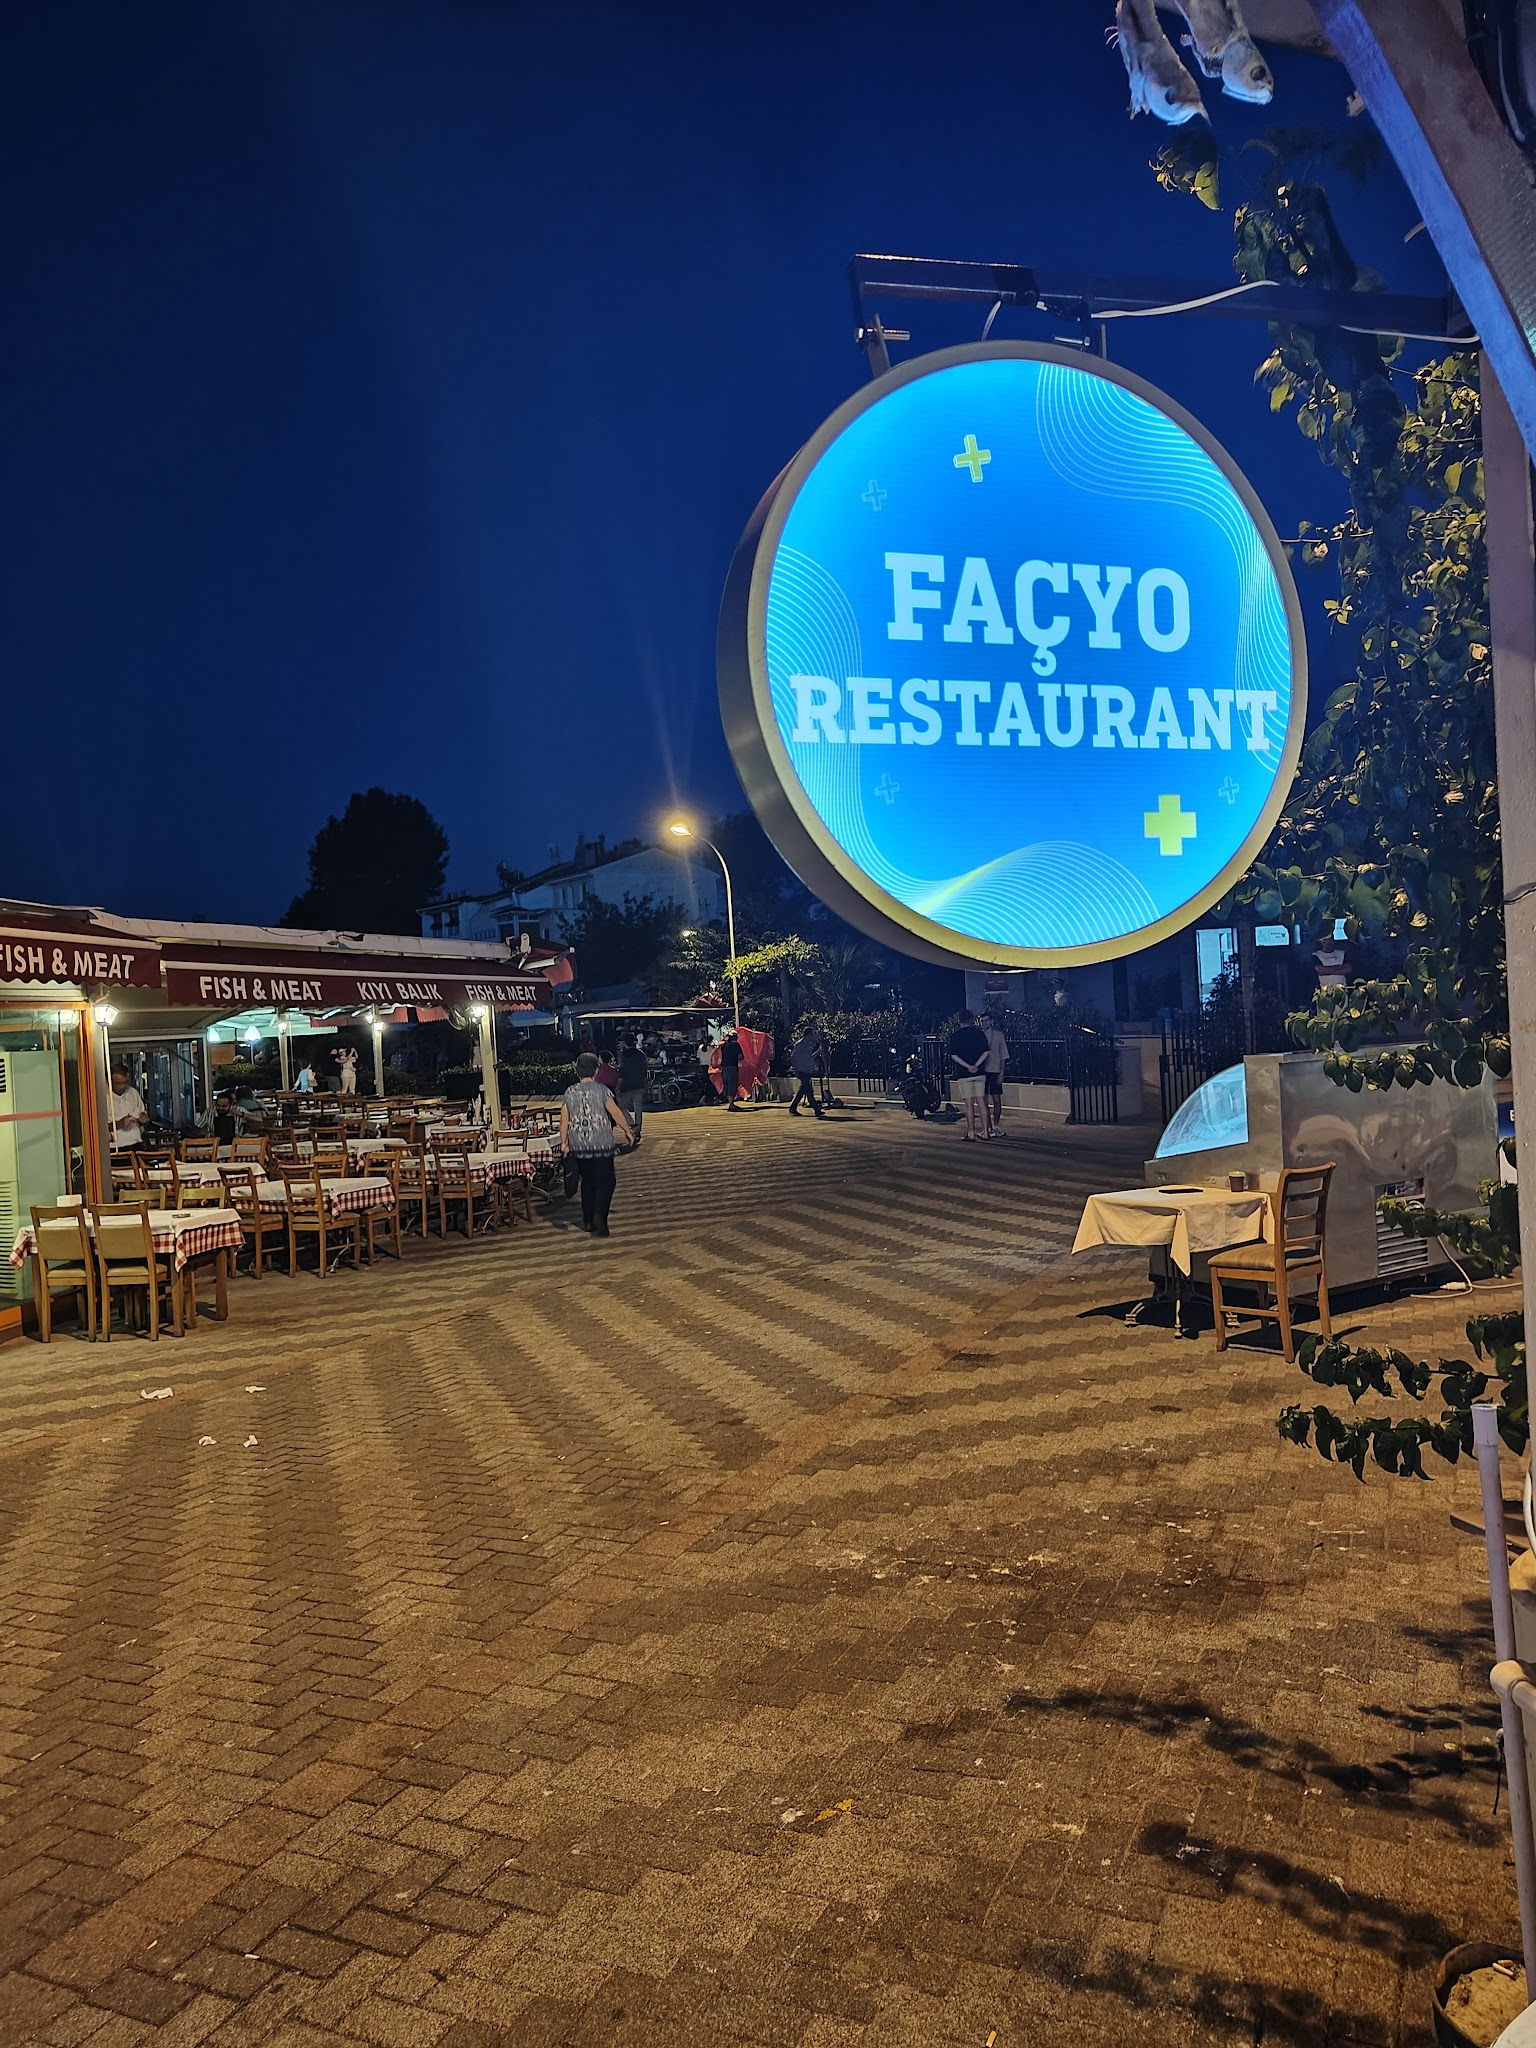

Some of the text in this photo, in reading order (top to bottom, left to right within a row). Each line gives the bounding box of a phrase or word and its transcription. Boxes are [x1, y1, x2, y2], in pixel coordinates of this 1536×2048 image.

[884, 552, 1190, 676] FAÇYO
[789, 674, 1277, 750] RESTAURANT
[0, 943, 135, 980] ISH & MEAT
[199, 976, 323, 1001] FISH & MEAT
[356, 982, 444, 1001] KIYI BALIK
[464, 984, 538, 1002] FISH & MEAT
